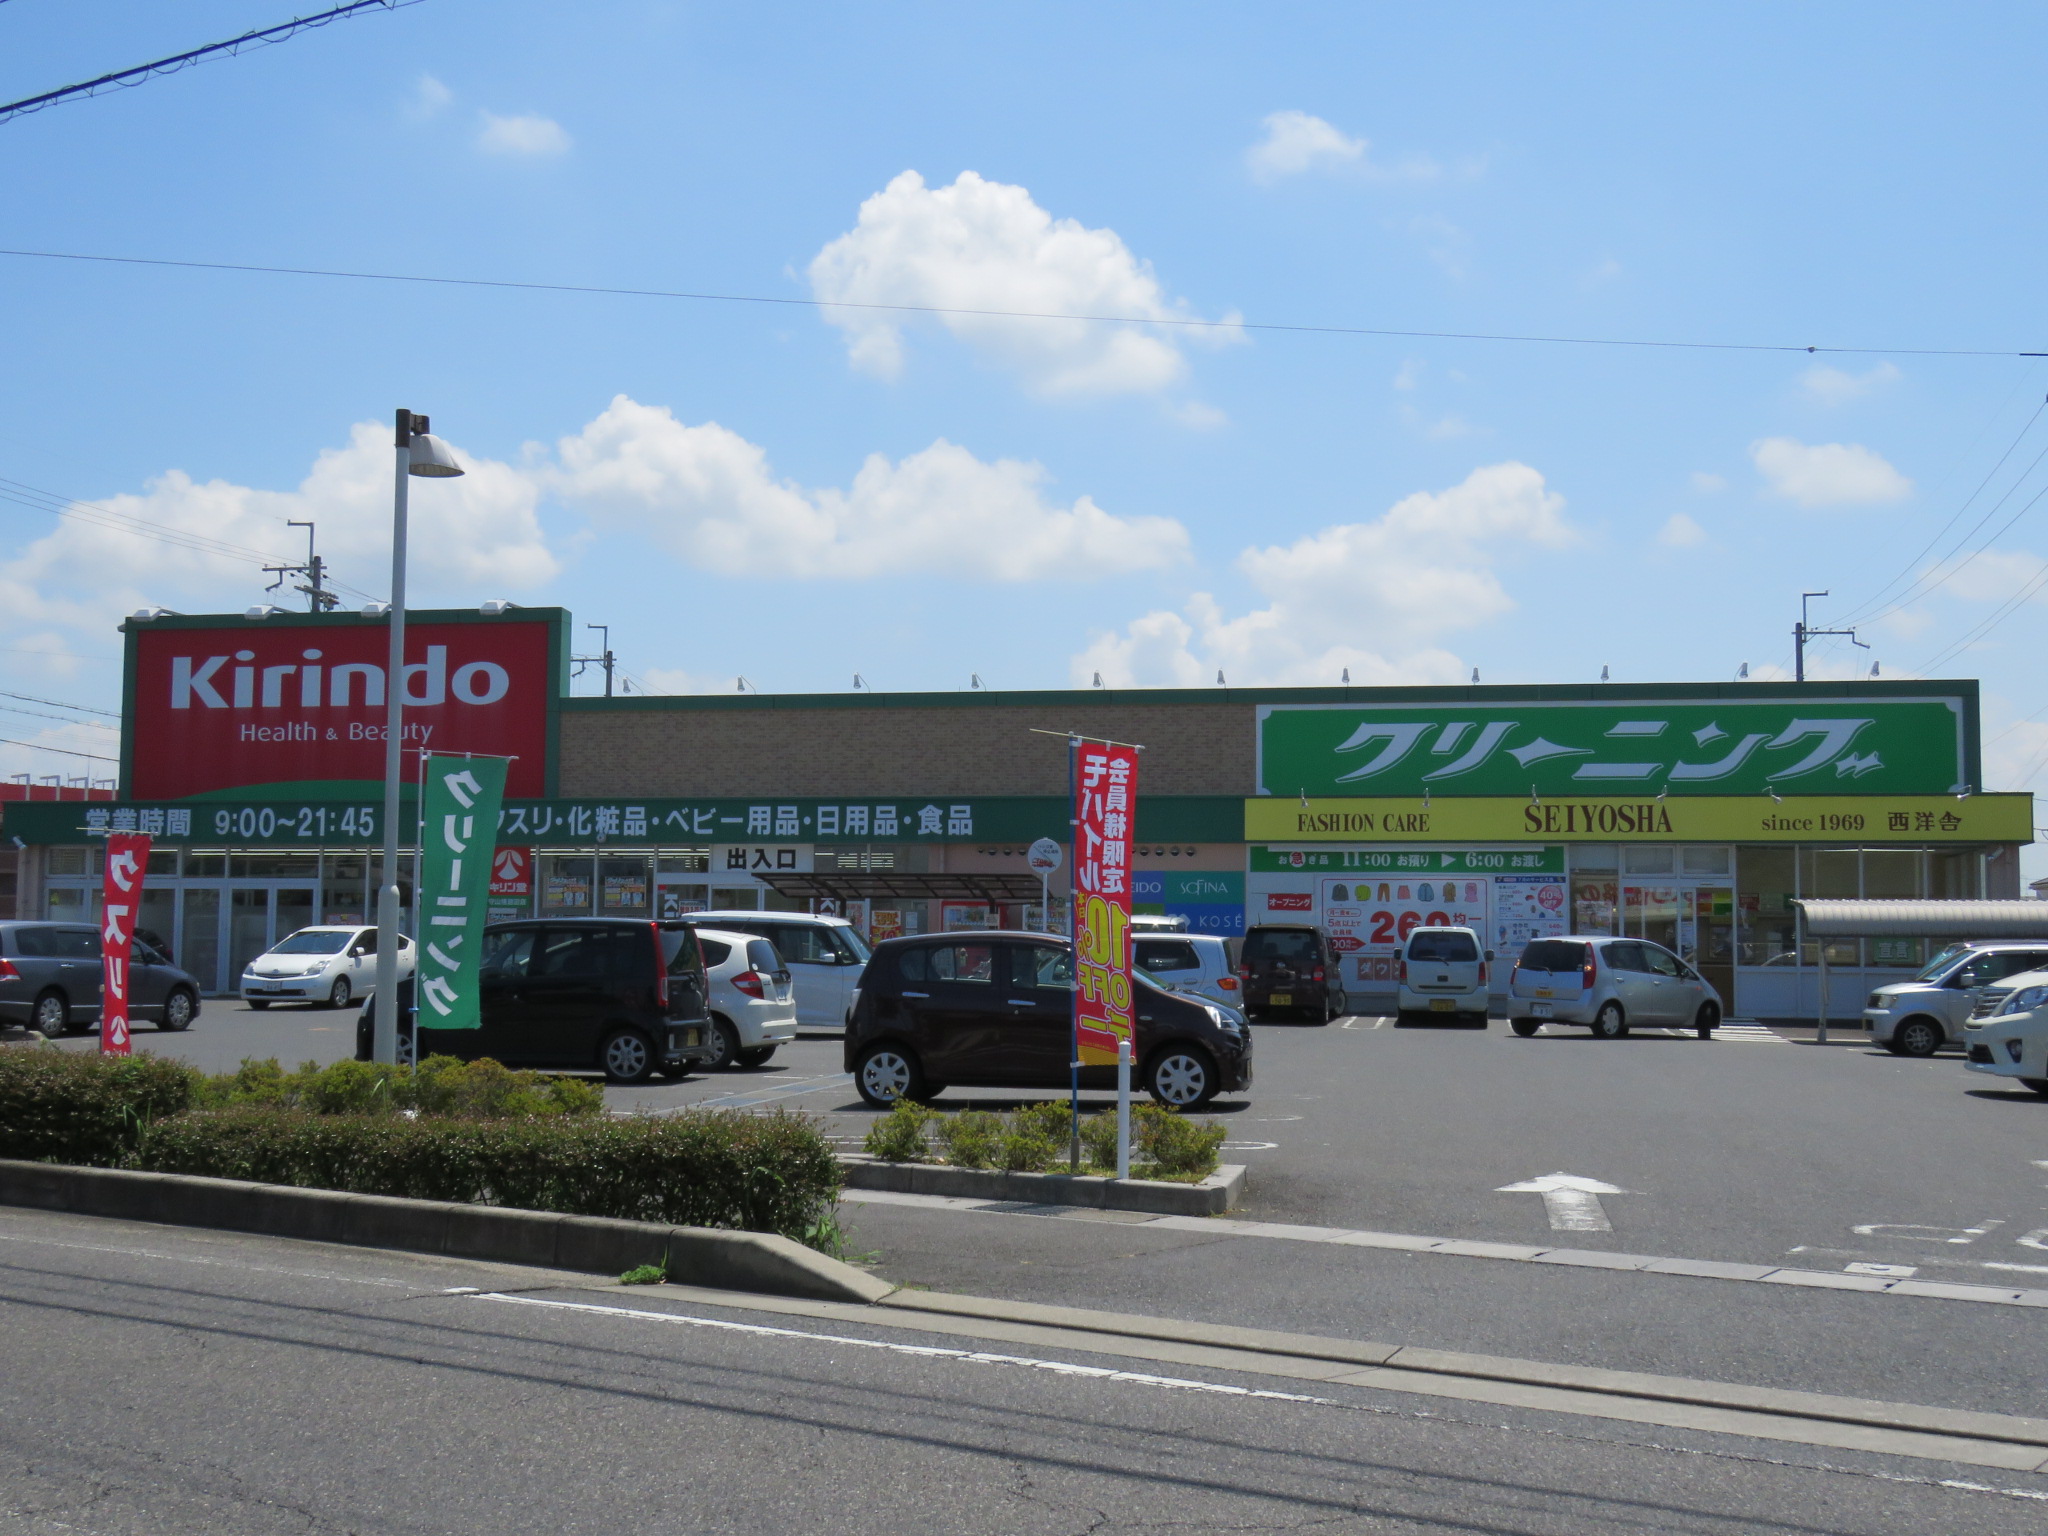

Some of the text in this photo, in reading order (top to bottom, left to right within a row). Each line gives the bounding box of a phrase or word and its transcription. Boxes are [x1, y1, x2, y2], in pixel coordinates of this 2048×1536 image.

[171, 644, 510, 710] Kirindo
[240, 721, 434, 744] Health & Beauty
[1334, 717, 1885, 783] クリーニング
[86, 808, 191, 838] 営業時間
[1297, 813, 1430, 833] FASHION CARE
[1524, 804, 1674, 834] SEIYOSHA
[1762, 814, 1865, 831] since 1969
[727, 848, 797, 870] 出入口
[1465, 852, 1504, 867] 6:00
[490, 882, 528, 893] キリン堂
[1200, 913, 1242, 927] KOSÉ
